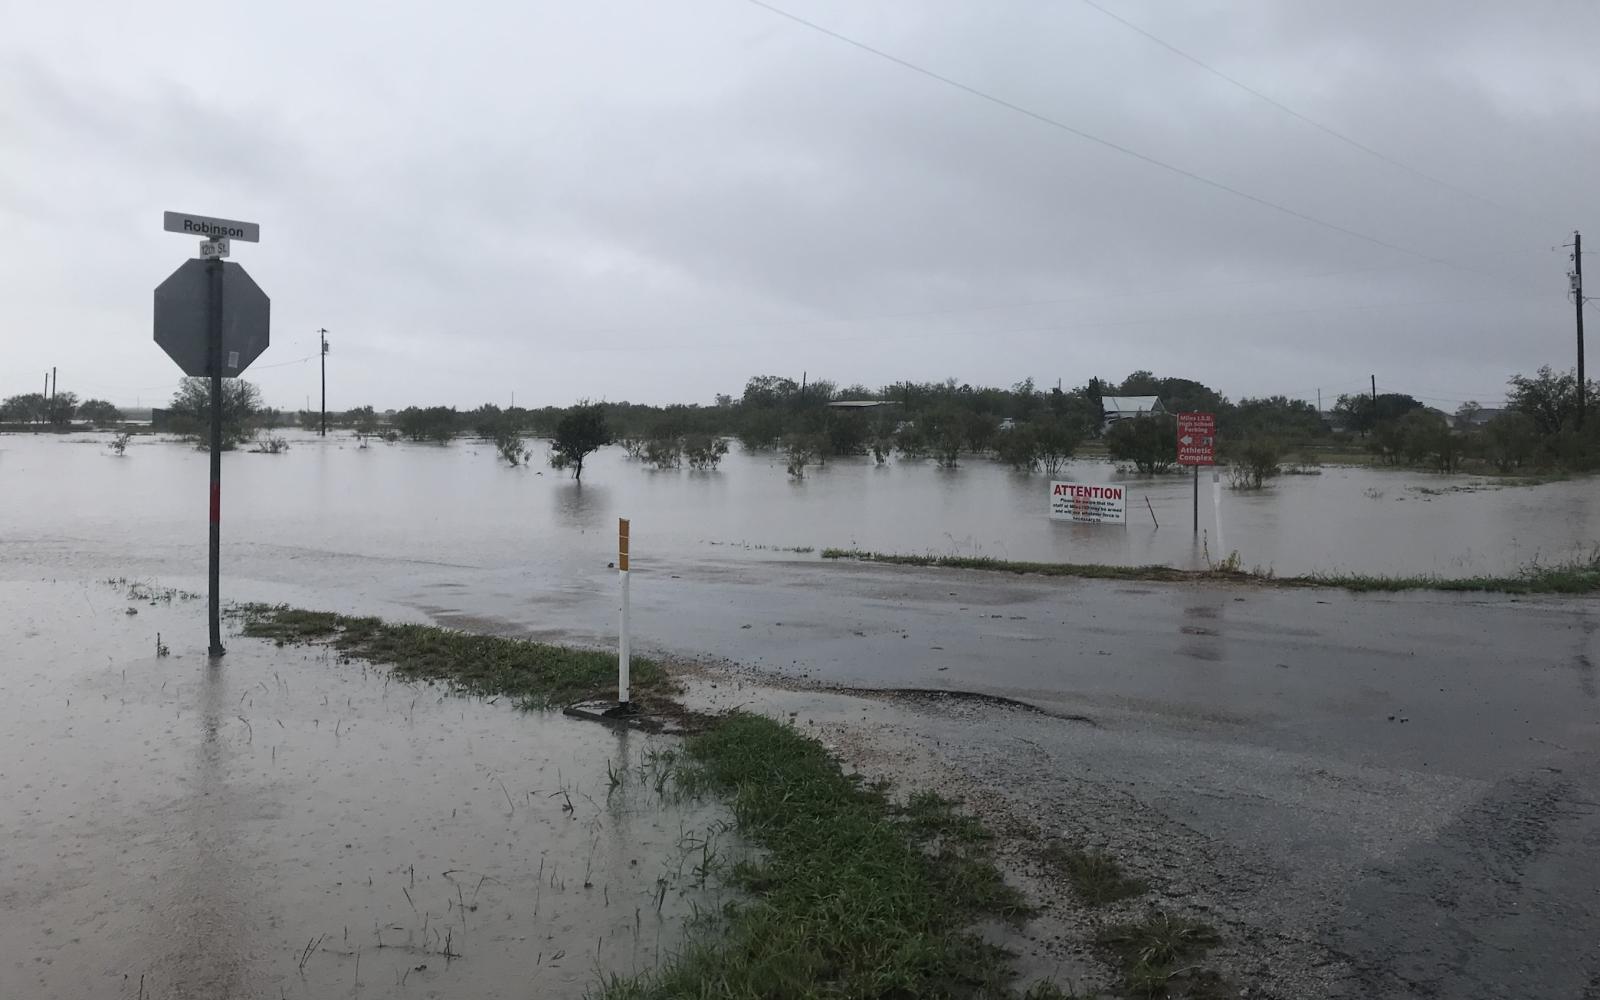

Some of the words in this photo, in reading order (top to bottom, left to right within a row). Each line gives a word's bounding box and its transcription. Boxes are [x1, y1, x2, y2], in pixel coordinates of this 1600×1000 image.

[183, 219, 244, 238] Robinson
[1179, 454, 1213, 462] Complex
[1053, 484, 1122, 500] ATTENTION
